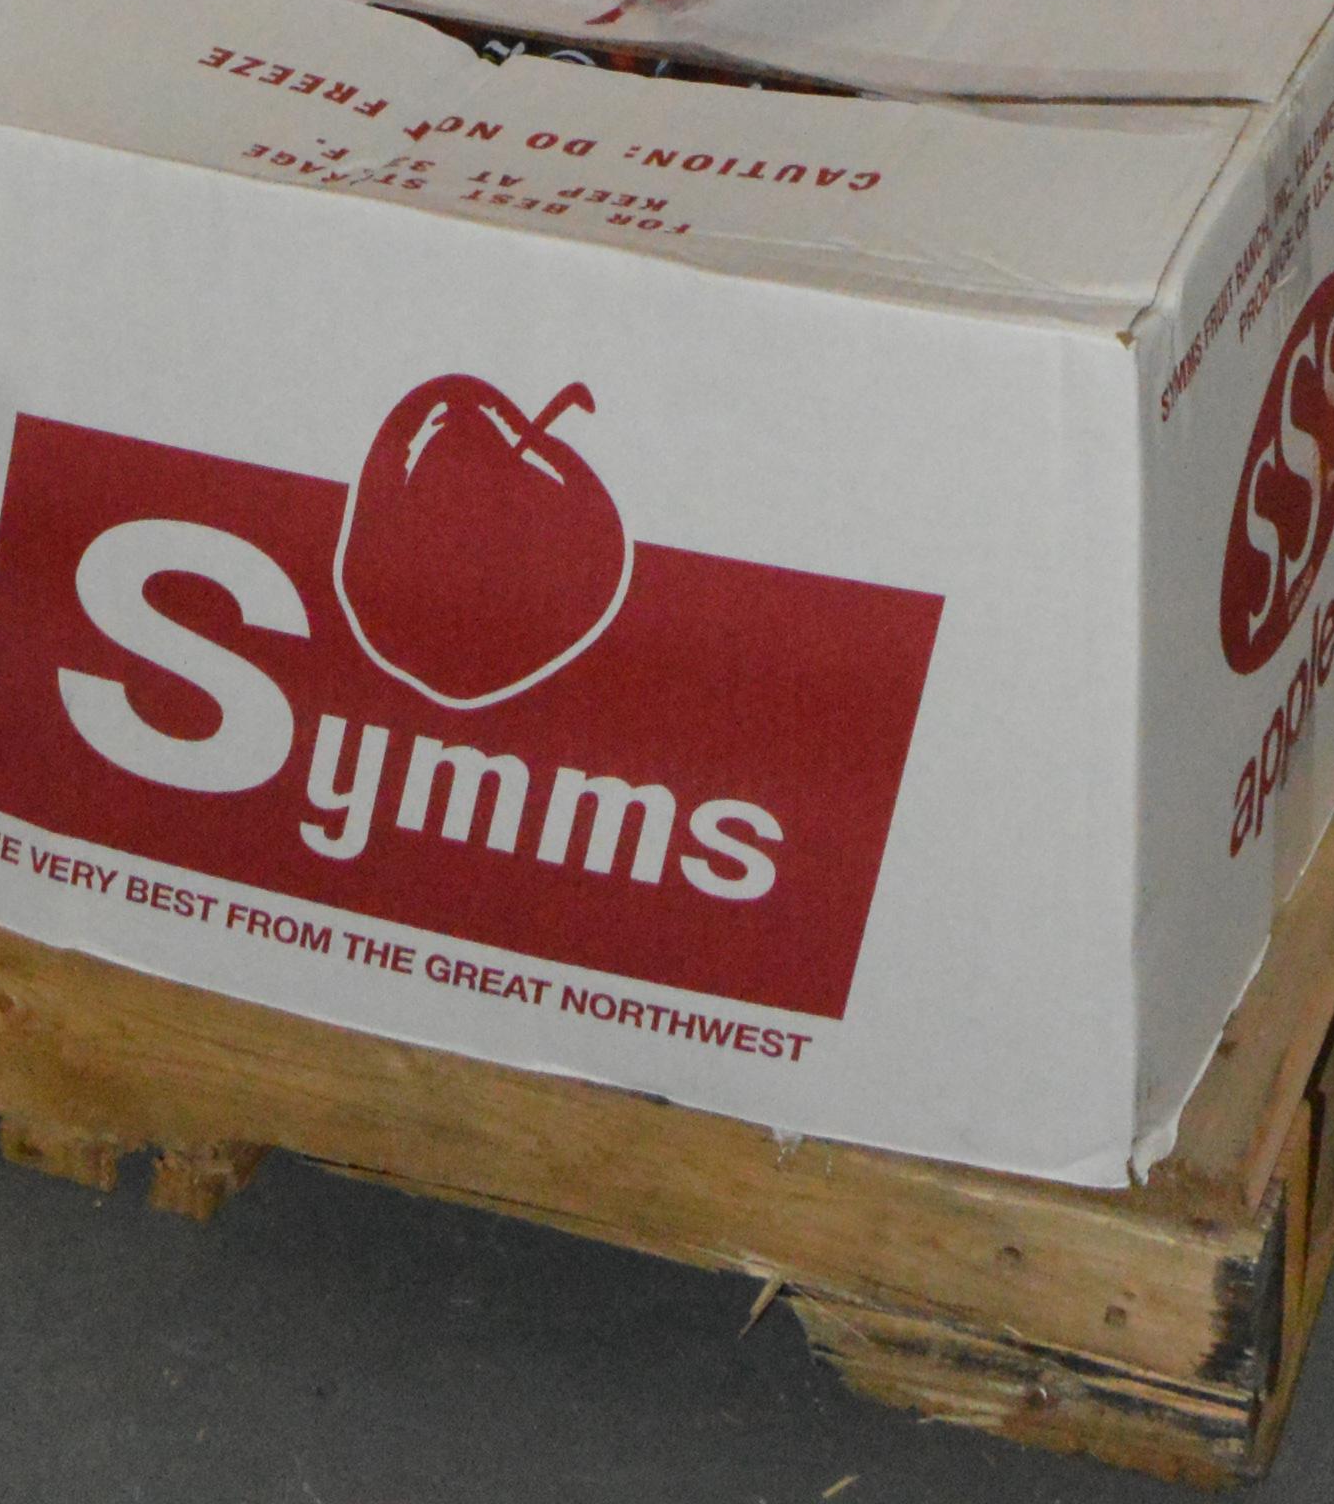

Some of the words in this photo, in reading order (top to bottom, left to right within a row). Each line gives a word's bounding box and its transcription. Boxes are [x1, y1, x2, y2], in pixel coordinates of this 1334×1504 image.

[198, 44, 389, 117] FREEZE
[406, 115, 503, 143] NOT
[526, 133, 597, 160] DO
[626, 144, 881, 191] CAUTION:
[57, 518, 786, 903] Symms
[30, 846, 119, 894] VERY
[125, 875, 219, 922] BEST
[226, 901, 333, 954] FROM
[343, 932, 416, 975] THE
[425, 953, 552, 1005] GREAT
[560, 985, 812, 1062] NORTHWEST
